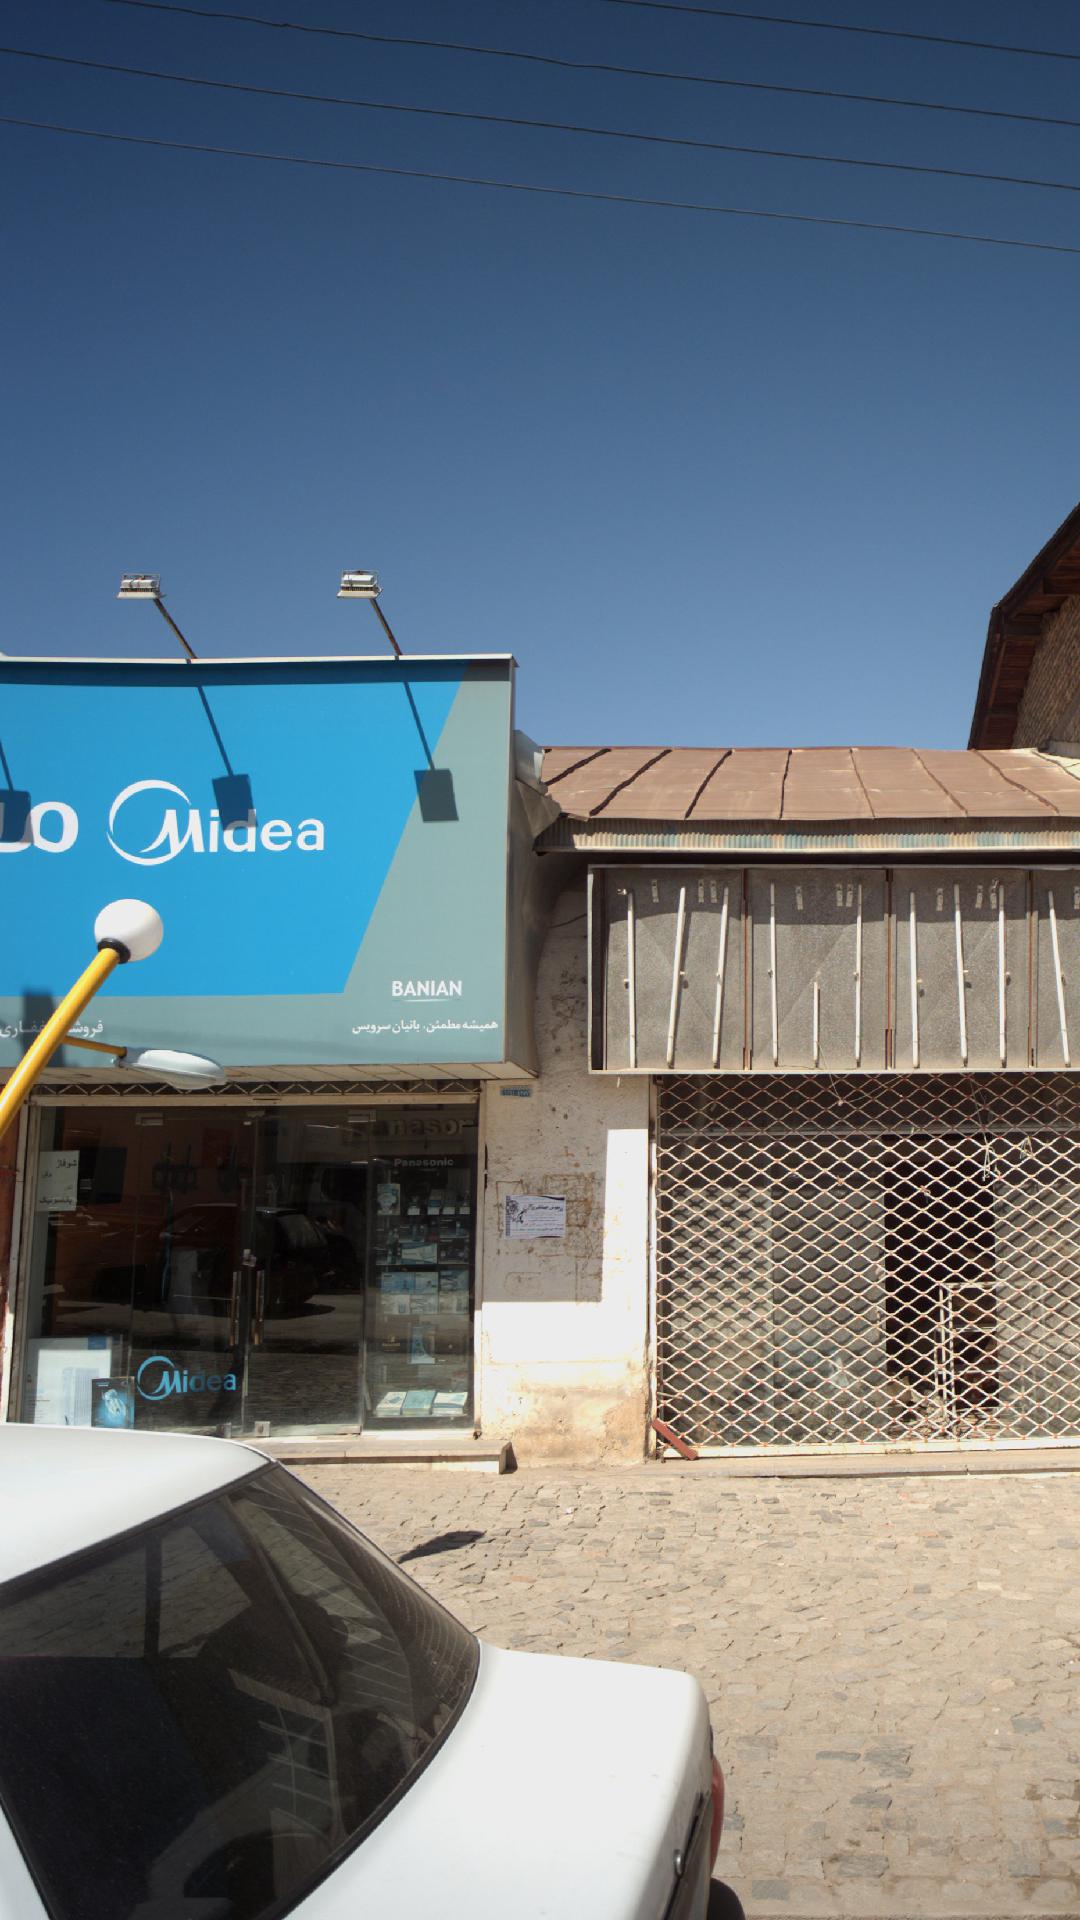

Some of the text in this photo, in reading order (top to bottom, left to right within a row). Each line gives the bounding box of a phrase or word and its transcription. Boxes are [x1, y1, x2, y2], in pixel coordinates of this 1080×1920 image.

[107, 808, 325, 866] Midea
[391, 980, 463, 997] BANIAN
[351, 1023, 391, 1035] سرویس
[391, 1019, 420, 1033] بانیان
[462, 1019, 499, 1032] همیشه
[393, 1156, 455, 1168] Panasonic
[137, 1369, 237, 1401] Midea
